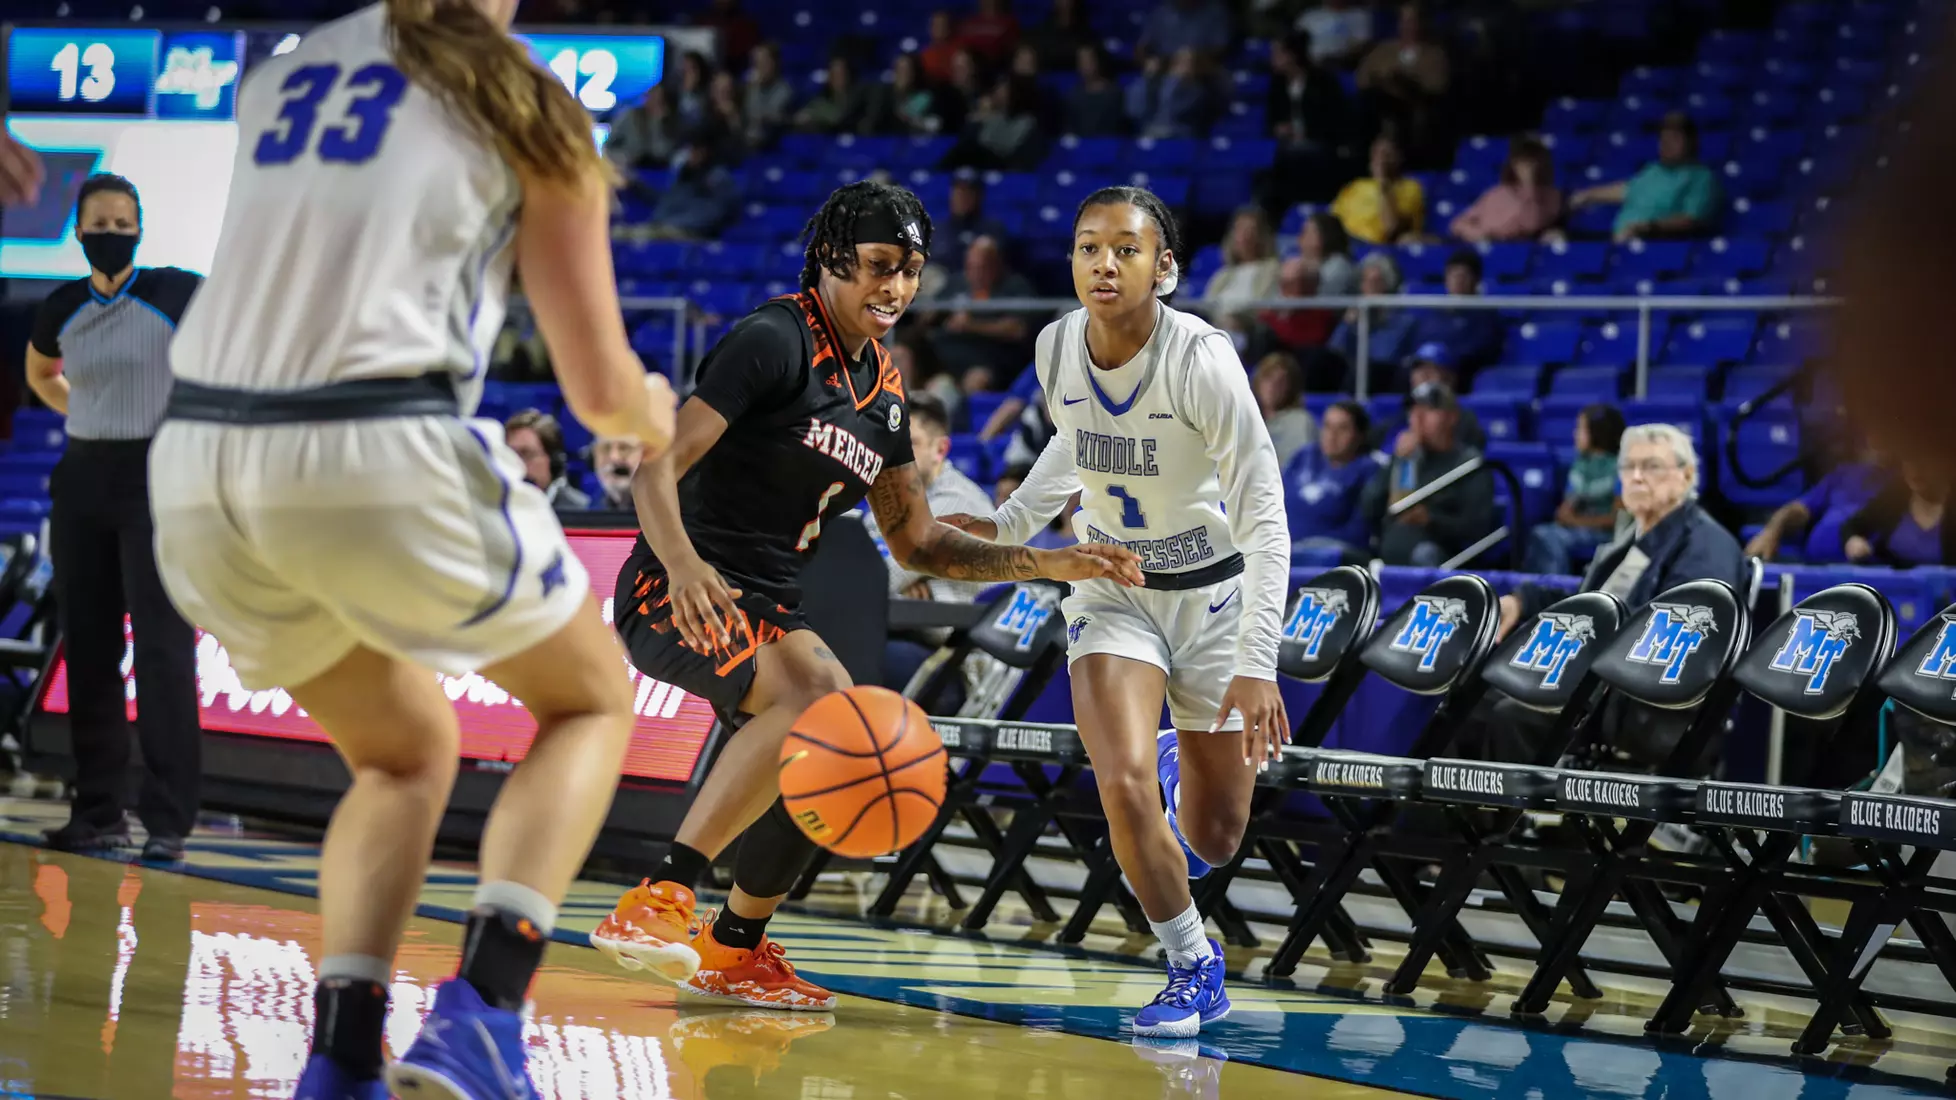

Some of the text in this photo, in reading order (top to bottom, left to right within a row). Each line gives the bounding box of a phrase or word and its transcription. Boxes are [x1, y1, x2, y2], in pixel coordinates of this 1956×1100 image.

[51, 43, 116, 102] 13
[253, 61, 411, 167] 33
[802, 417, 884, 486] MERCER
[1075, 428, 1159, 477] MIDDLE
[1105, 483, 1149, 530] 1
[1086, 524, 1215, 571] TESSEE
[1281, 593, 1338, 662] MT
[1389, 601, 1456, 673] MT
[1625, 608, 1704, 685] MT
[1509, 617, 1585, 690] MT
[1768, 615, 1848, 696] MT
[996, 727, 1052, 751] BLUE RAIDERS
[1316, 762, 1383, 787] BLUE RAIDERS
[1431, 765, 1504, 795] BLUE RAIDERS
[1565, 777, 1640, 808] BLUE RAIDERS
[1706, 788, 1784, 818] BLUE RAIDERS
[1850, 800, 1940, 835] BLUE RAIDERS
